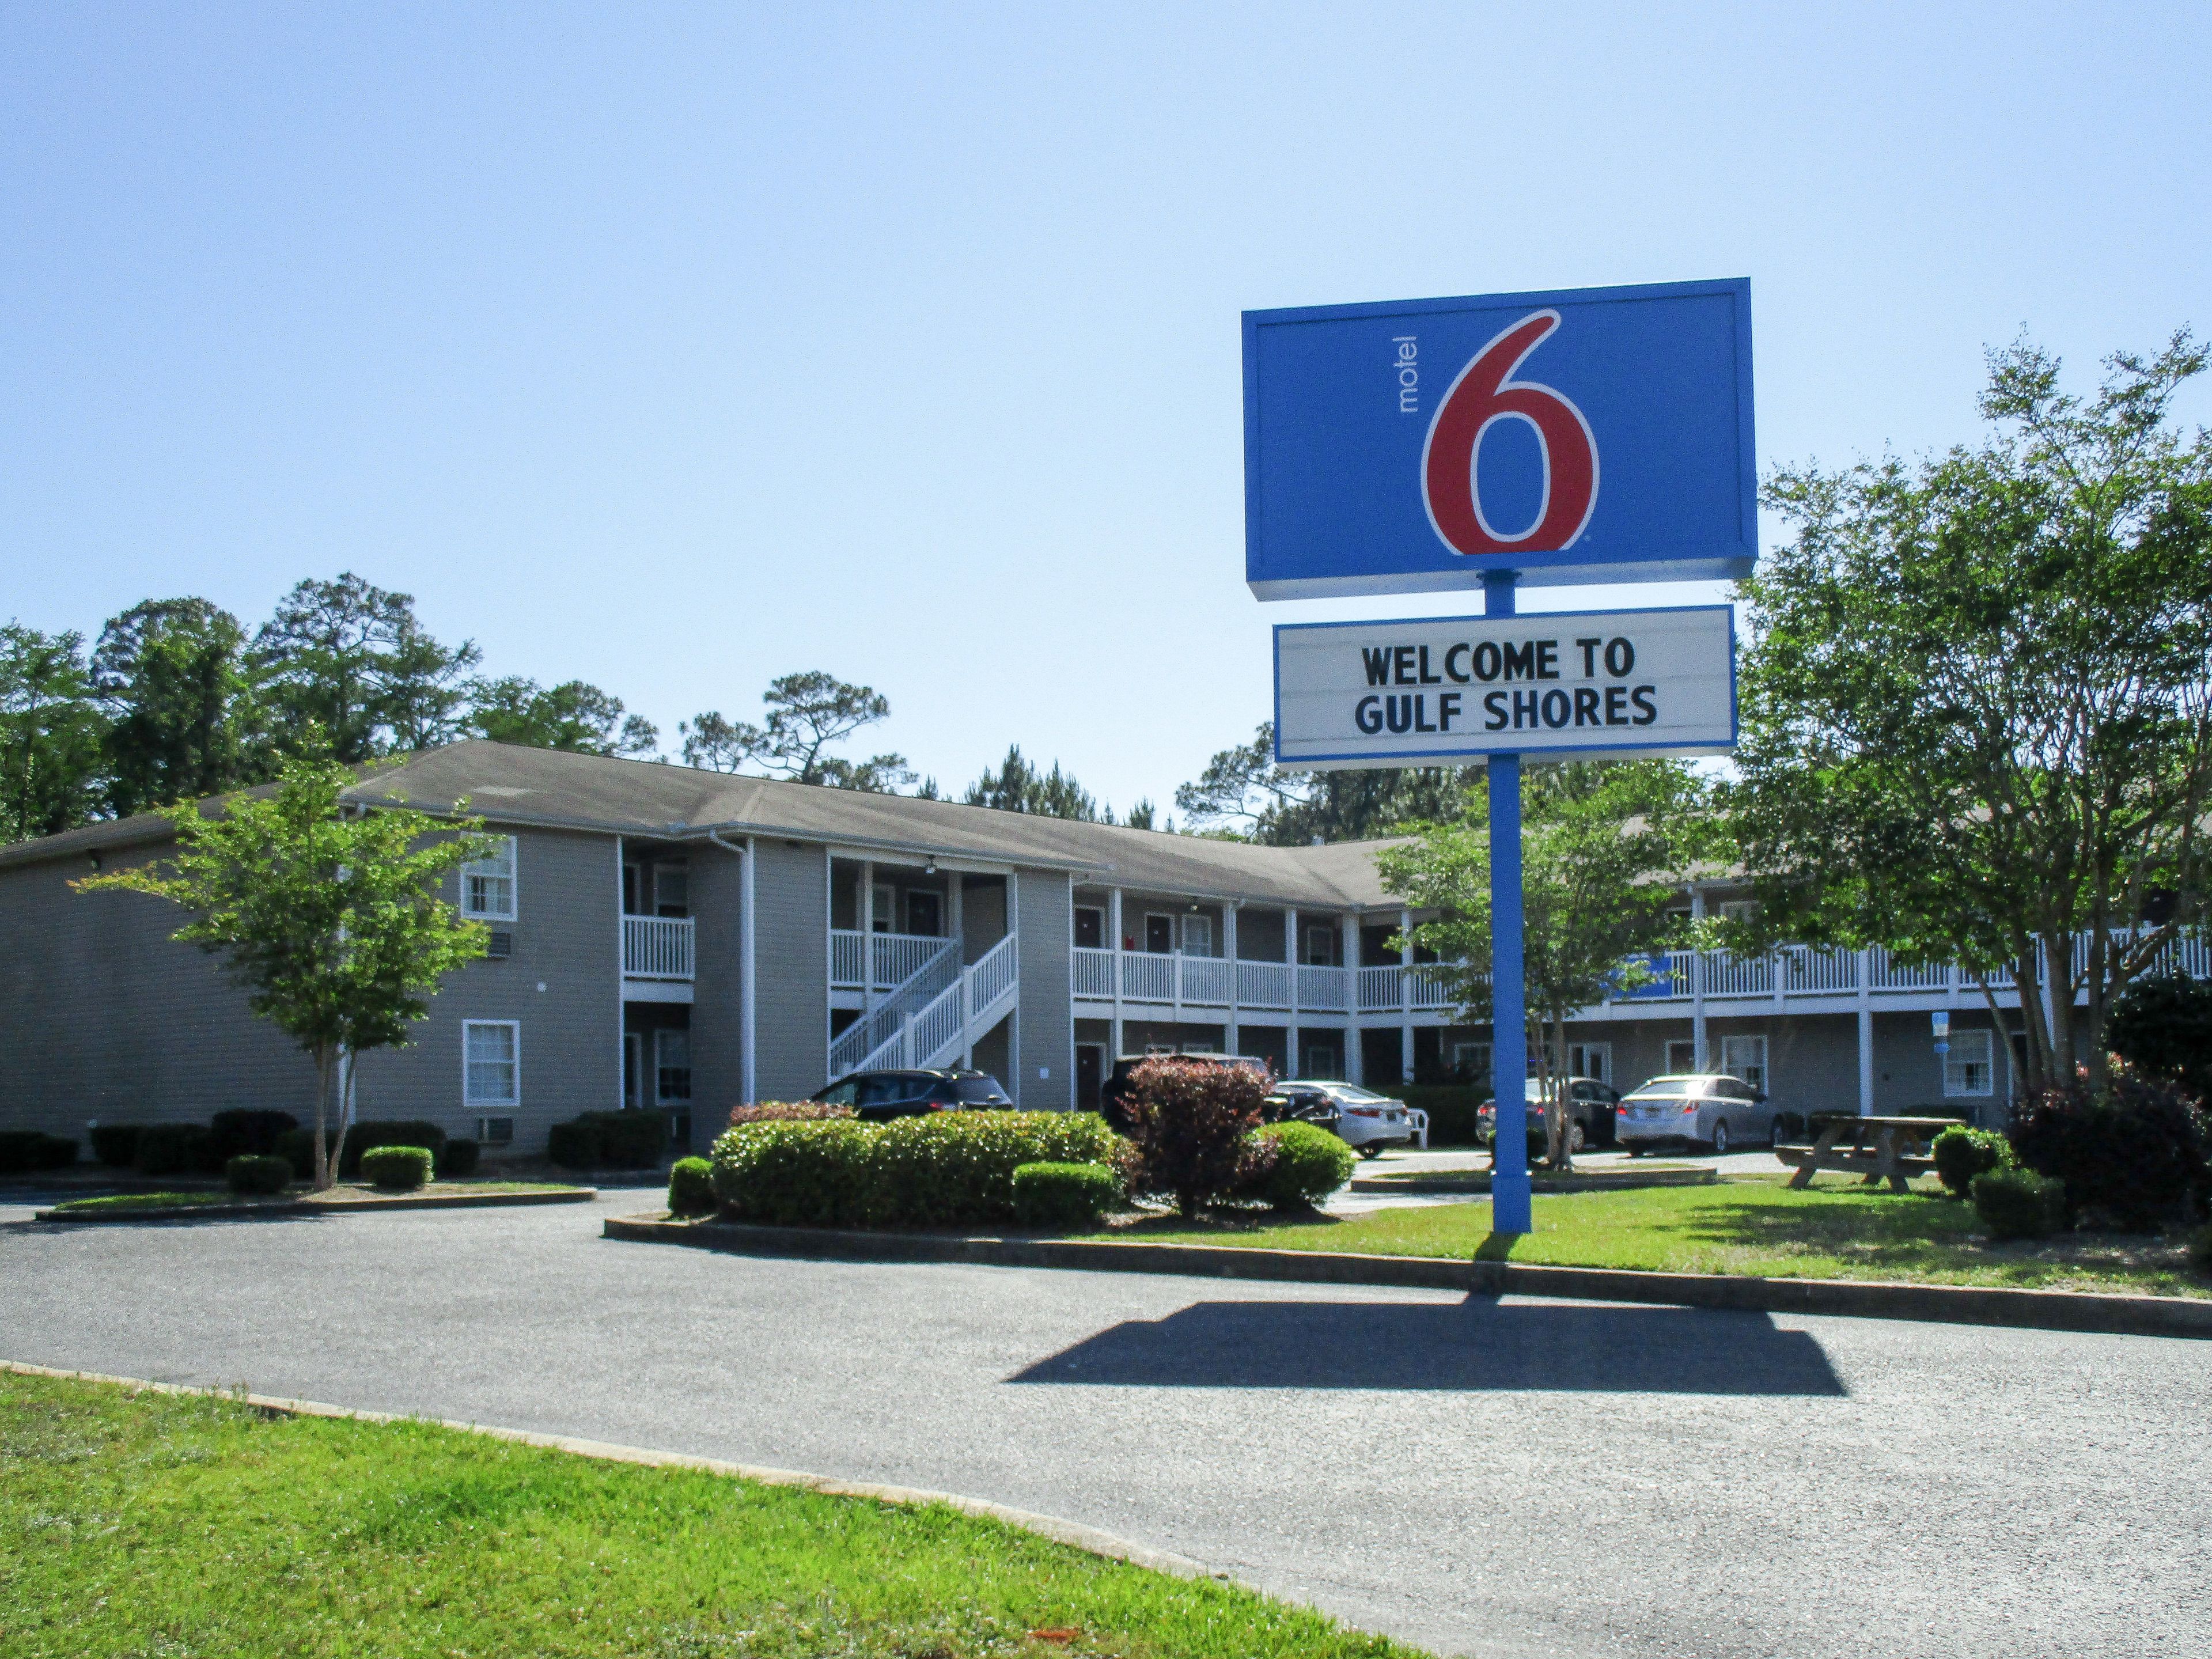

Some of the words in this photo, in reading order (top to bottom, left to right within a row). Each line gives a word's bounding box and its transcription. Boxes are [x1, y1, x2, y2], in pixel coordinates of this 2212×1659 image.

[1392, 336, 1418, 412] motel
[1420, 308, 1601, 556] 6
[1361, 641, 1558, 687] WELCOME
[1575, 637, 1635, 679] TO
[1354, 692, 1462, 735] GULF
[1483, 684, 1657, 731] SHORES
